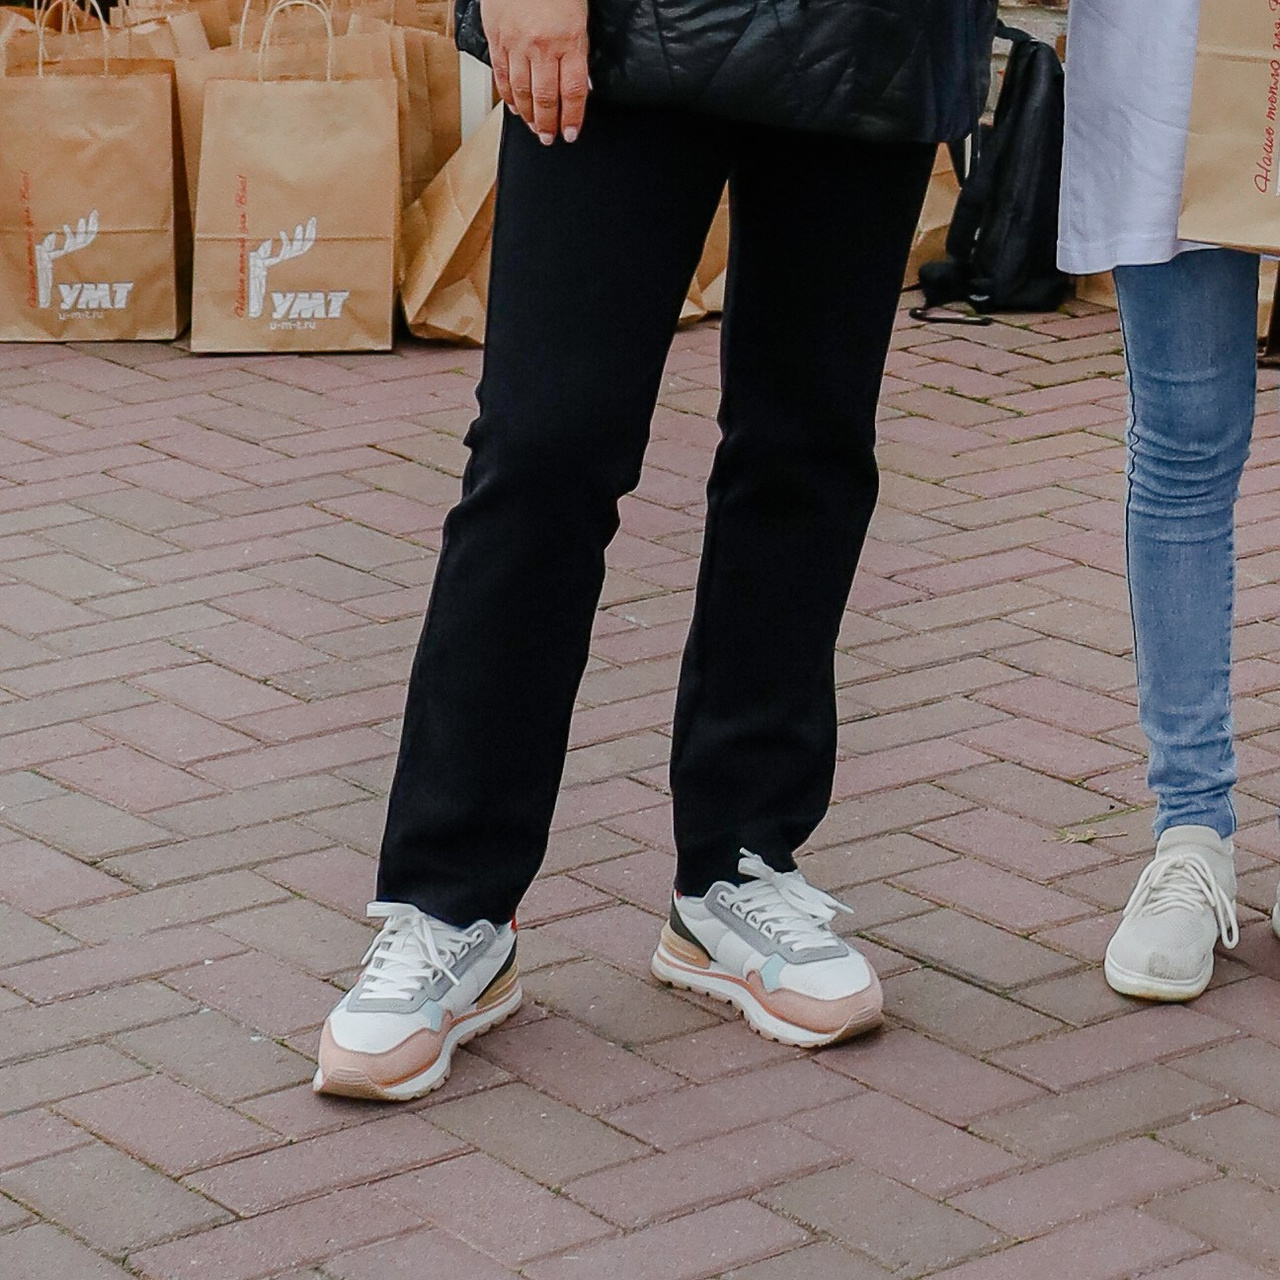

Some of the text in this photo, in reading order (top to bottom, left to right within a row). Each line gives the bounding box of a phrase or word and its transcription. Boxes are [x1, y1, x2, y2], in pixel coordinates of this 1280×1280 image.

[1253, 125, 1275, 193] Наше
[1266, 59, 1280, 122] тепло
[58, 282, 134, 310] УМТ
[270, 291, 350, 319] УМТ
